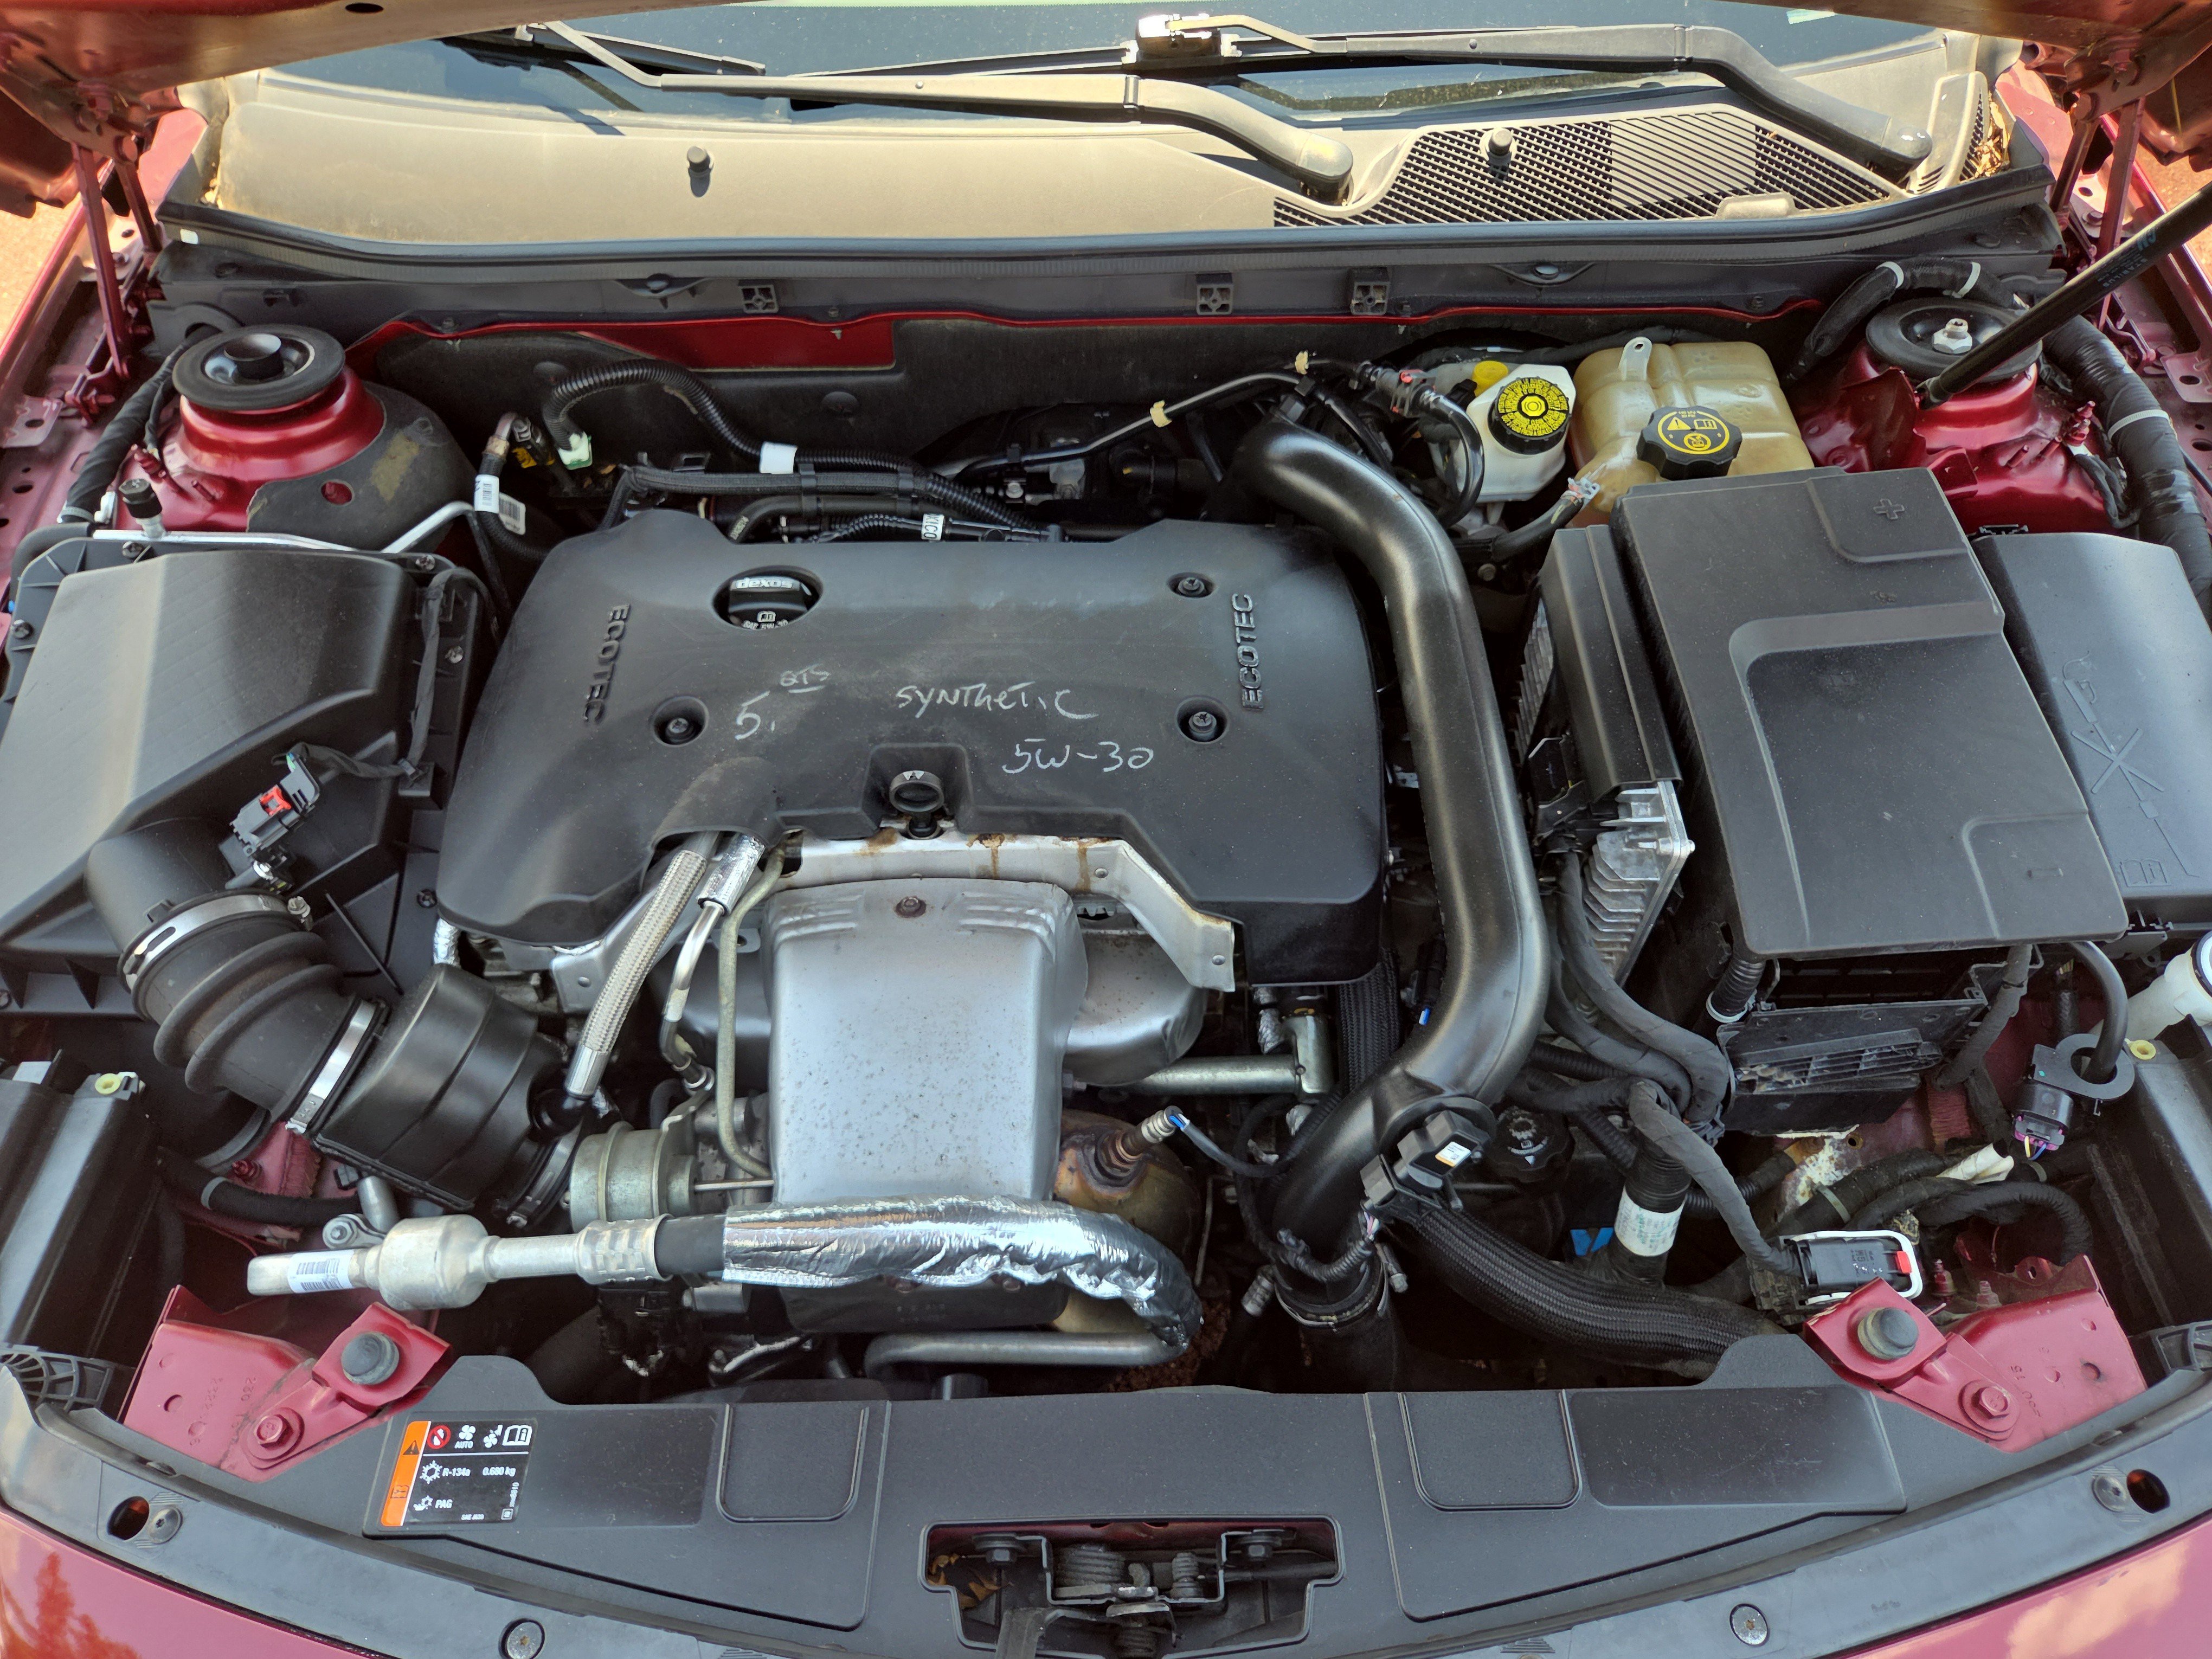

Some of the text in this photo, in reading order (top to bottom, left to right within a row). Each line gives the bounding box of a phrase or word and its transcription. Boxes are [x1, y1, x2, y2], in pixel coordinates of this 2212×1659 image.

[736, 577, 793, 589] dexos
[1231, 593, 1264, 709] ECOTEC
[583, 603, 631, 724] ECOTEC
[1002, 738, 1154, 774] 5W-30
[454, 1441, 473, 1449] AUTO
[435, 1499, 453, 1509] PAG
